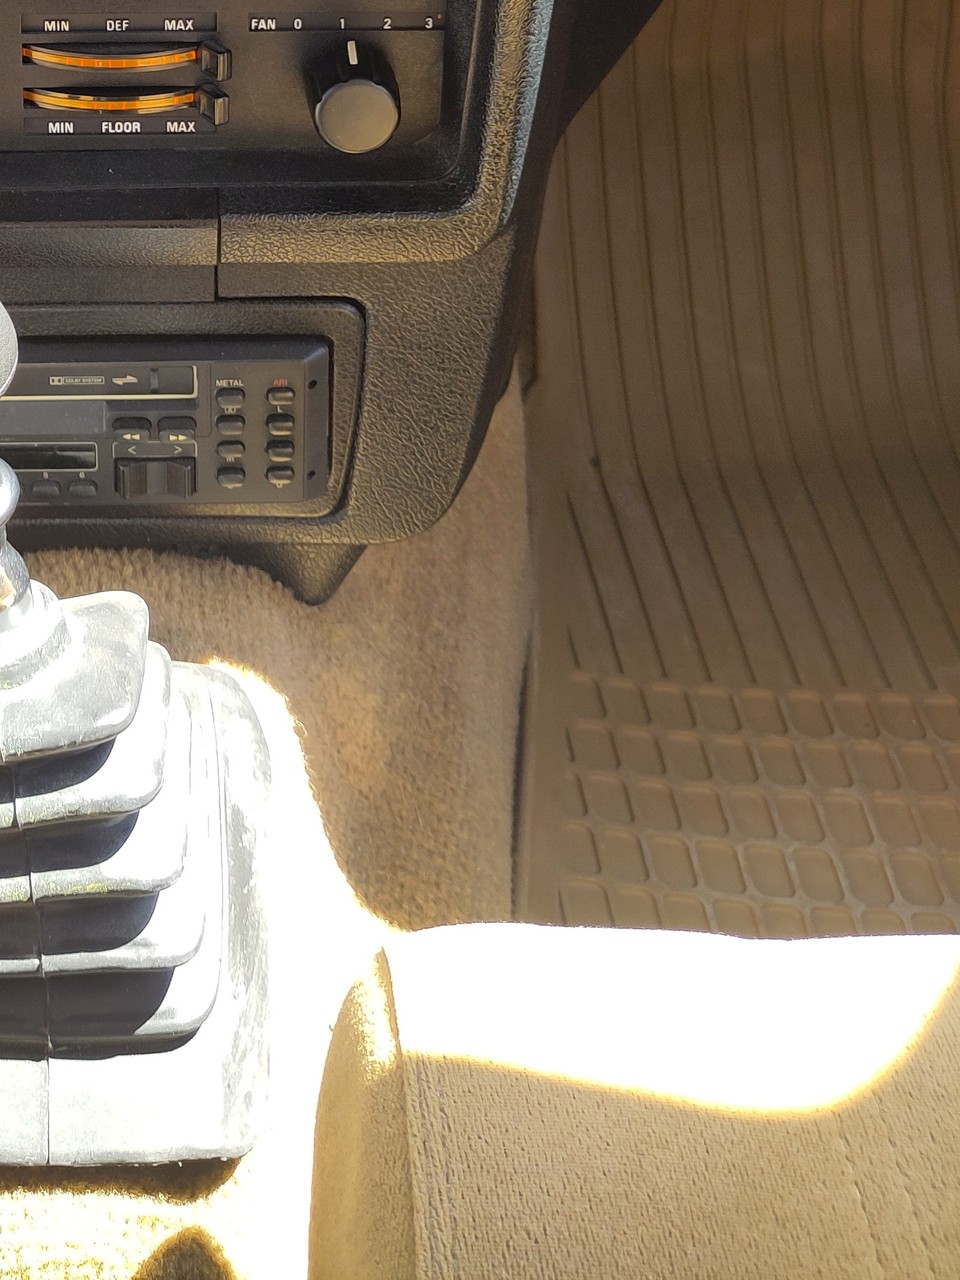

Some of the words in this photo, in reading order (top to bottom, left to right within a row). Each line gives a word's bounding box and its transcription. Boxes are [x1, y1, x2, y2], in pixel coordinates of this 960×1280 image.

[44, 20, 70, 32] MIN
[106, 19, 130, 31] DEF
[164, 19, 194, 31] MAX
[251, 18, 276, 30] FAN
[293, 18, 302, 30] 0
[340, 18, 345, 29] 1
[383, 18, 392, 29] 2
[425, 17, 433, 29] 3
[48, 122, 74, 134] MIN
[101, 121, 141, 133] FLOOR
[166, 121, 196, 133] MAX
[215, 379, 244, 387] METAL
